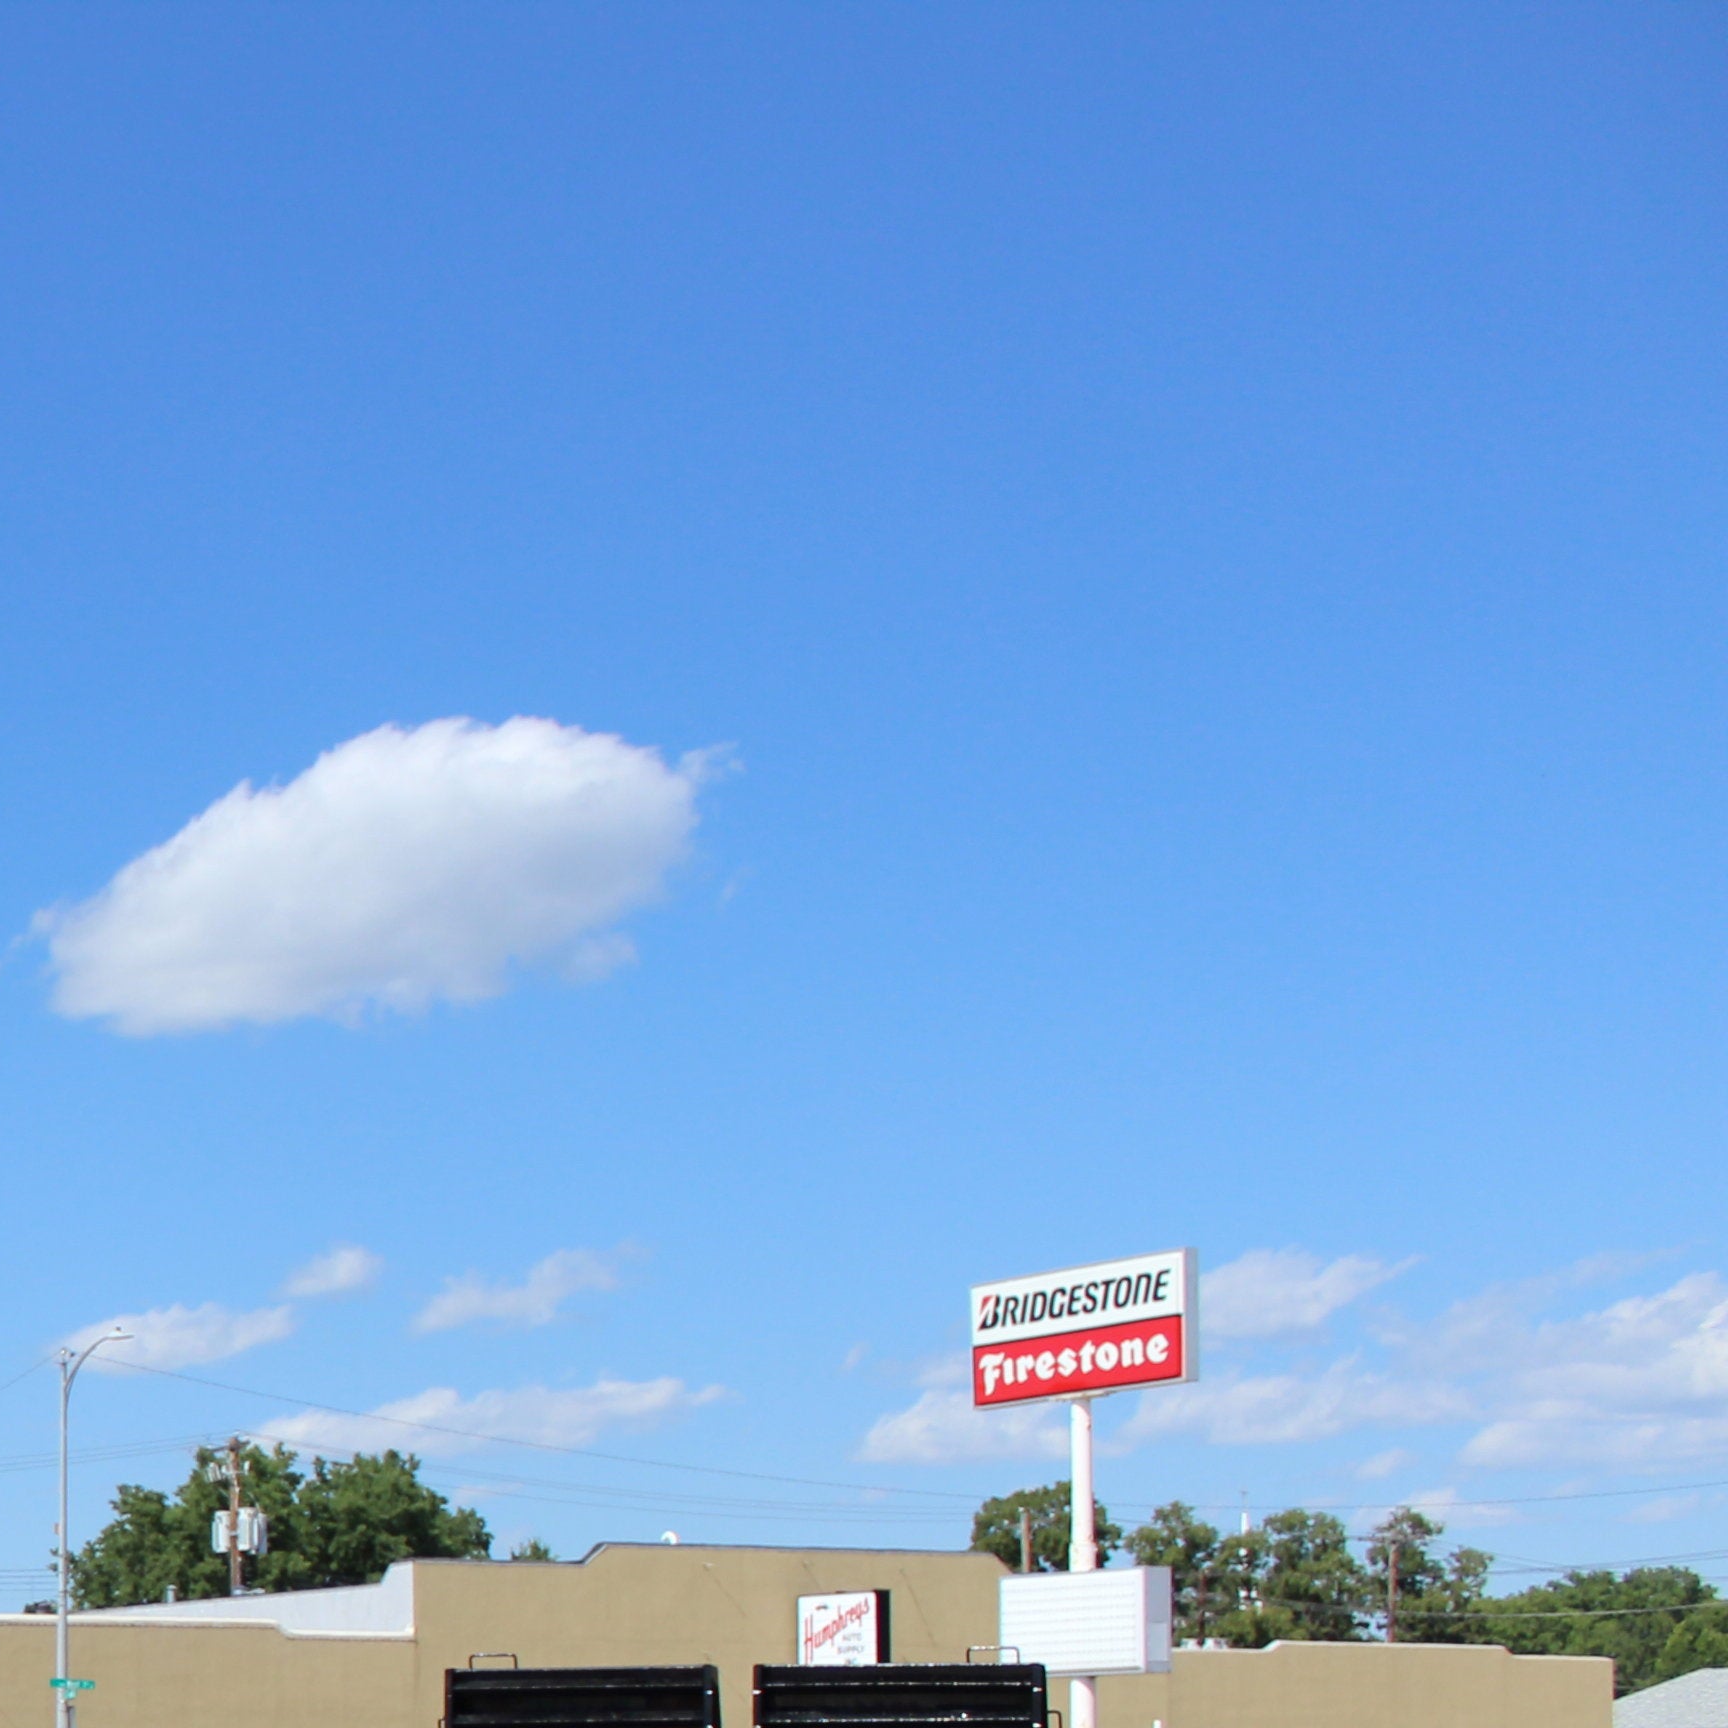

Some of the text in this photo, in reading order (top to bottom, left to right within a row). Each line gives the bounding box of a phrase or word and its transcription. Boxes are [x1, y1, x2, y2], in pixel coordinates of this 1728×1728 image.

[978, 1268, 1171, 1331] BRIDGESTONE
[979, 1334, 1169, 1396] Firestone
[804, 1597, 870, 1666] Humphreys
